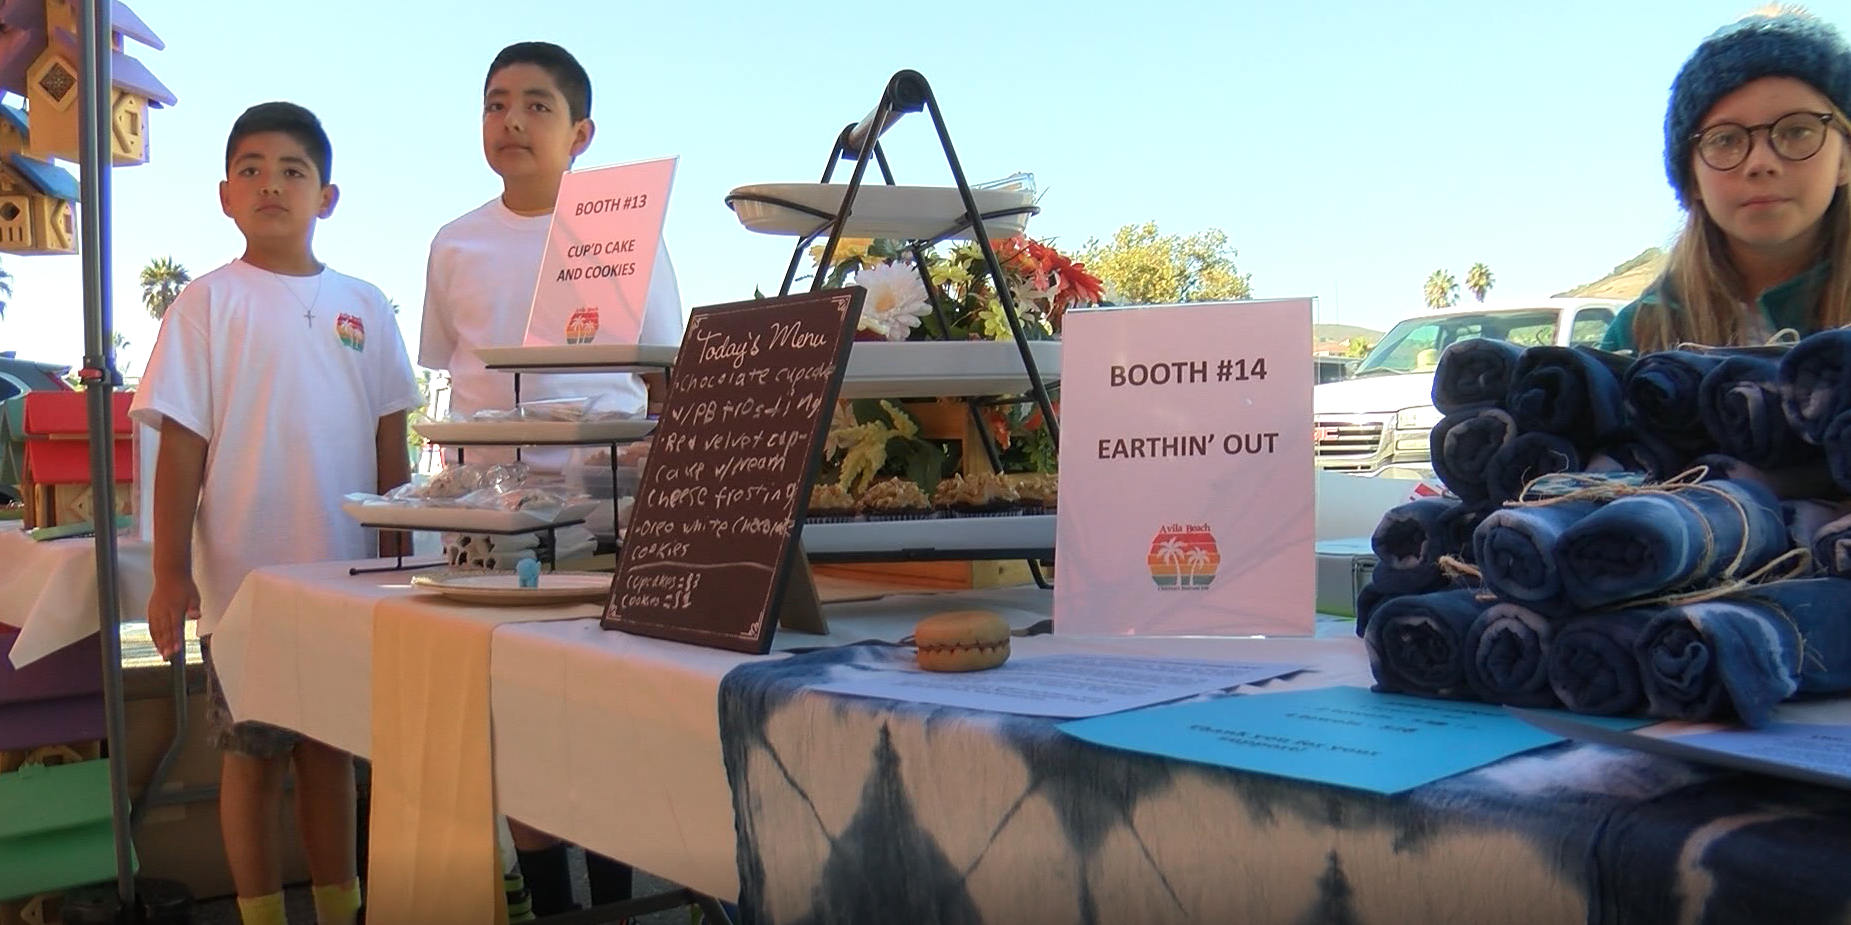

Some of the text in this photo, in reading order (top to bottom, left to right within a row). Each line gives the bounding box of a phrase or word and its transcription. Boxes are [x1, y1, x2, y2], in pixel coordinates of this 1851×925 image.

[575, 194, 648, 216] BOOTH #13
[567, 239, 636, 258] CUP'D CAKE
[556, 262, 636, 282] AND COOKIES
[697, 320, 827, 368] Today's Menu
[1110, 358, 1268, 387] BOOTH #14
[705, 430, 764, 452] velvet
[1223, 432, 1280, 456] OUT
[715, 482, 798, 511] frosting
[1159, 522, 1211, 534] Avila Beach
